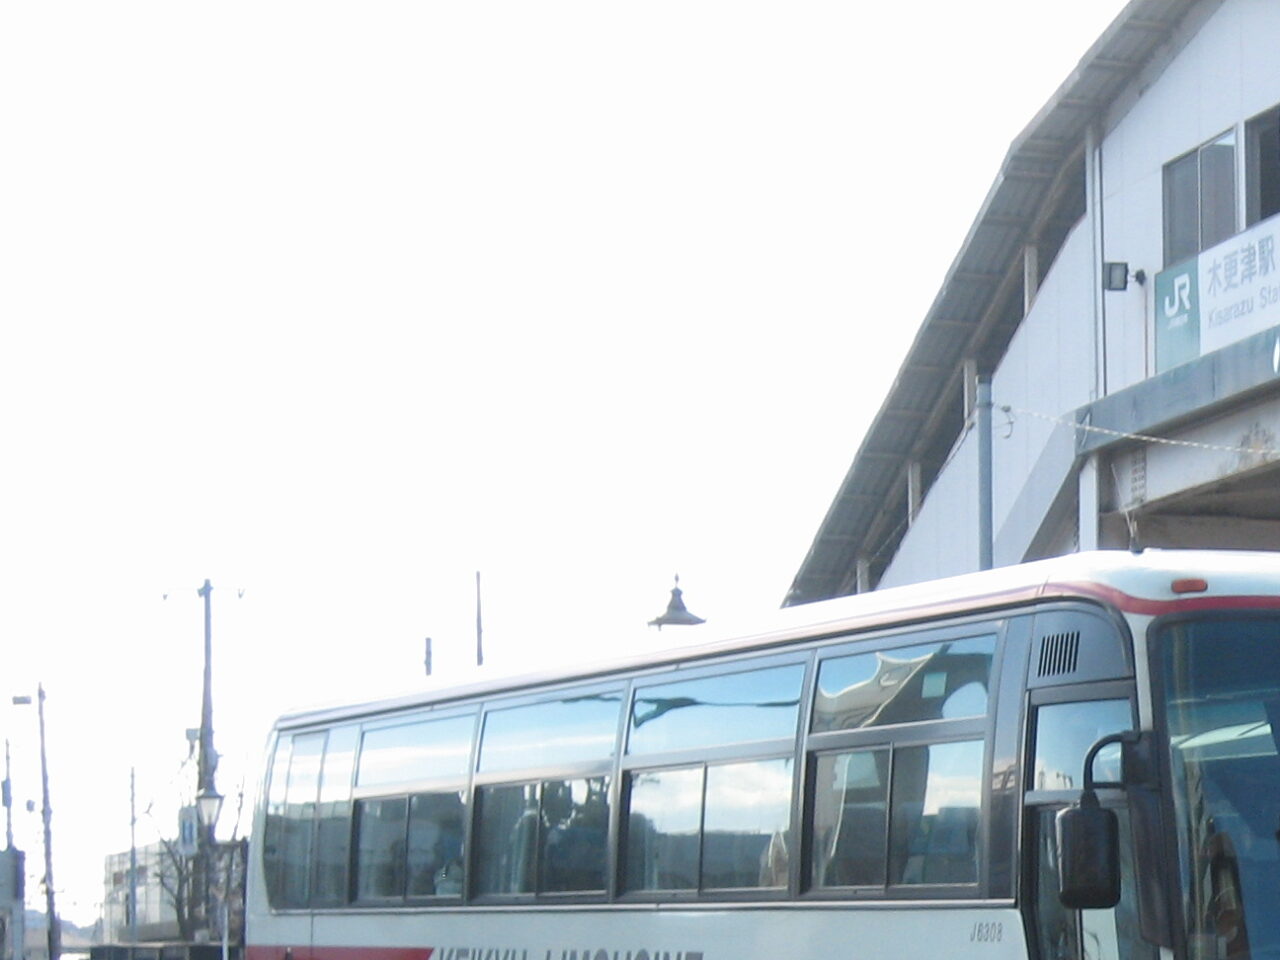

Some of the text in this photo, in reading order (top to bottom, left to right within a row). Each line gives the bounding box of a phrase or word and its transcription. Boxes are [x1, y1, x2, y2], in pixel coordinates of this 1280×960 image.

[1208, 234, 1276, 297] 木更津駅
[1164, 273, 1191, 317] JR
[970, 921, 1003, 942] J6308
